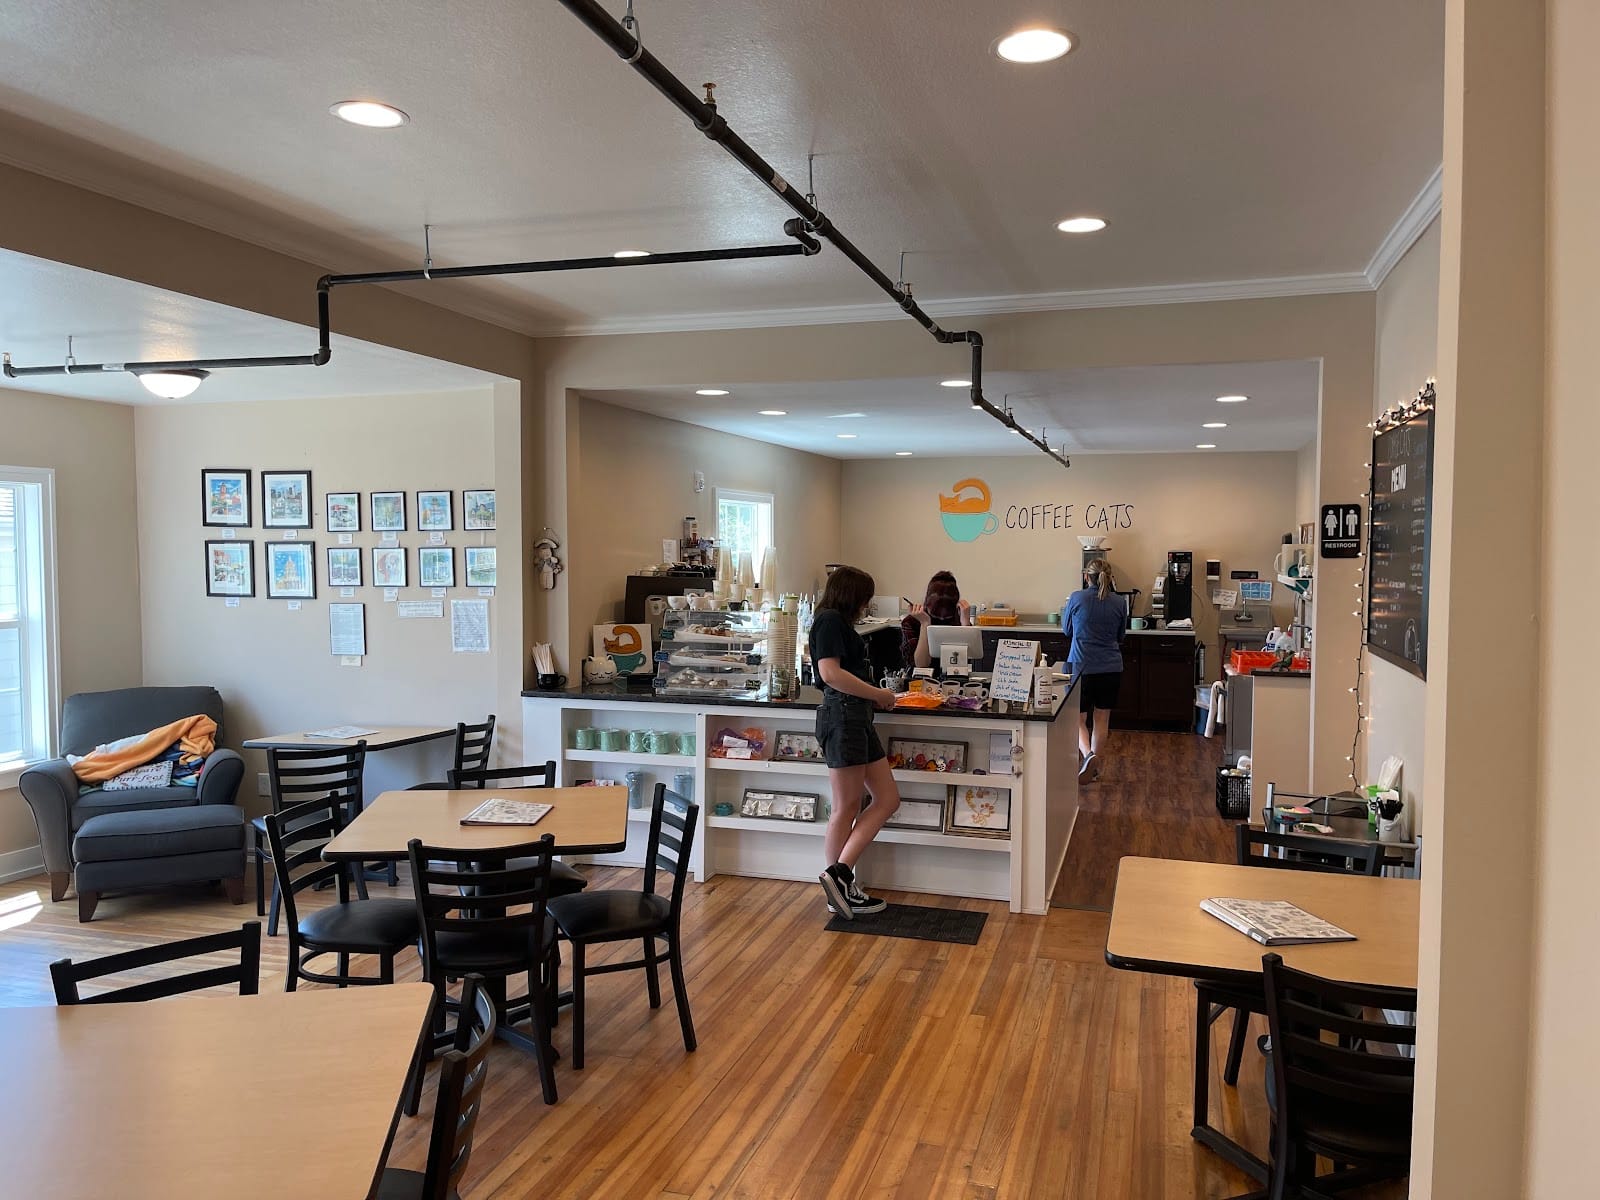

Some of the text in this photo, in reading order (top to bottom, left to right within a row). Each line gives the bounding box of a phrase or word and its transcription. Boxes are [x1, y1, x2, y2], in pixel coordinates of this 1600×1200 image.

[1391, 463, 1406, 493] MENU
[1005, 503, 1135, 531] COFFEE CATS
